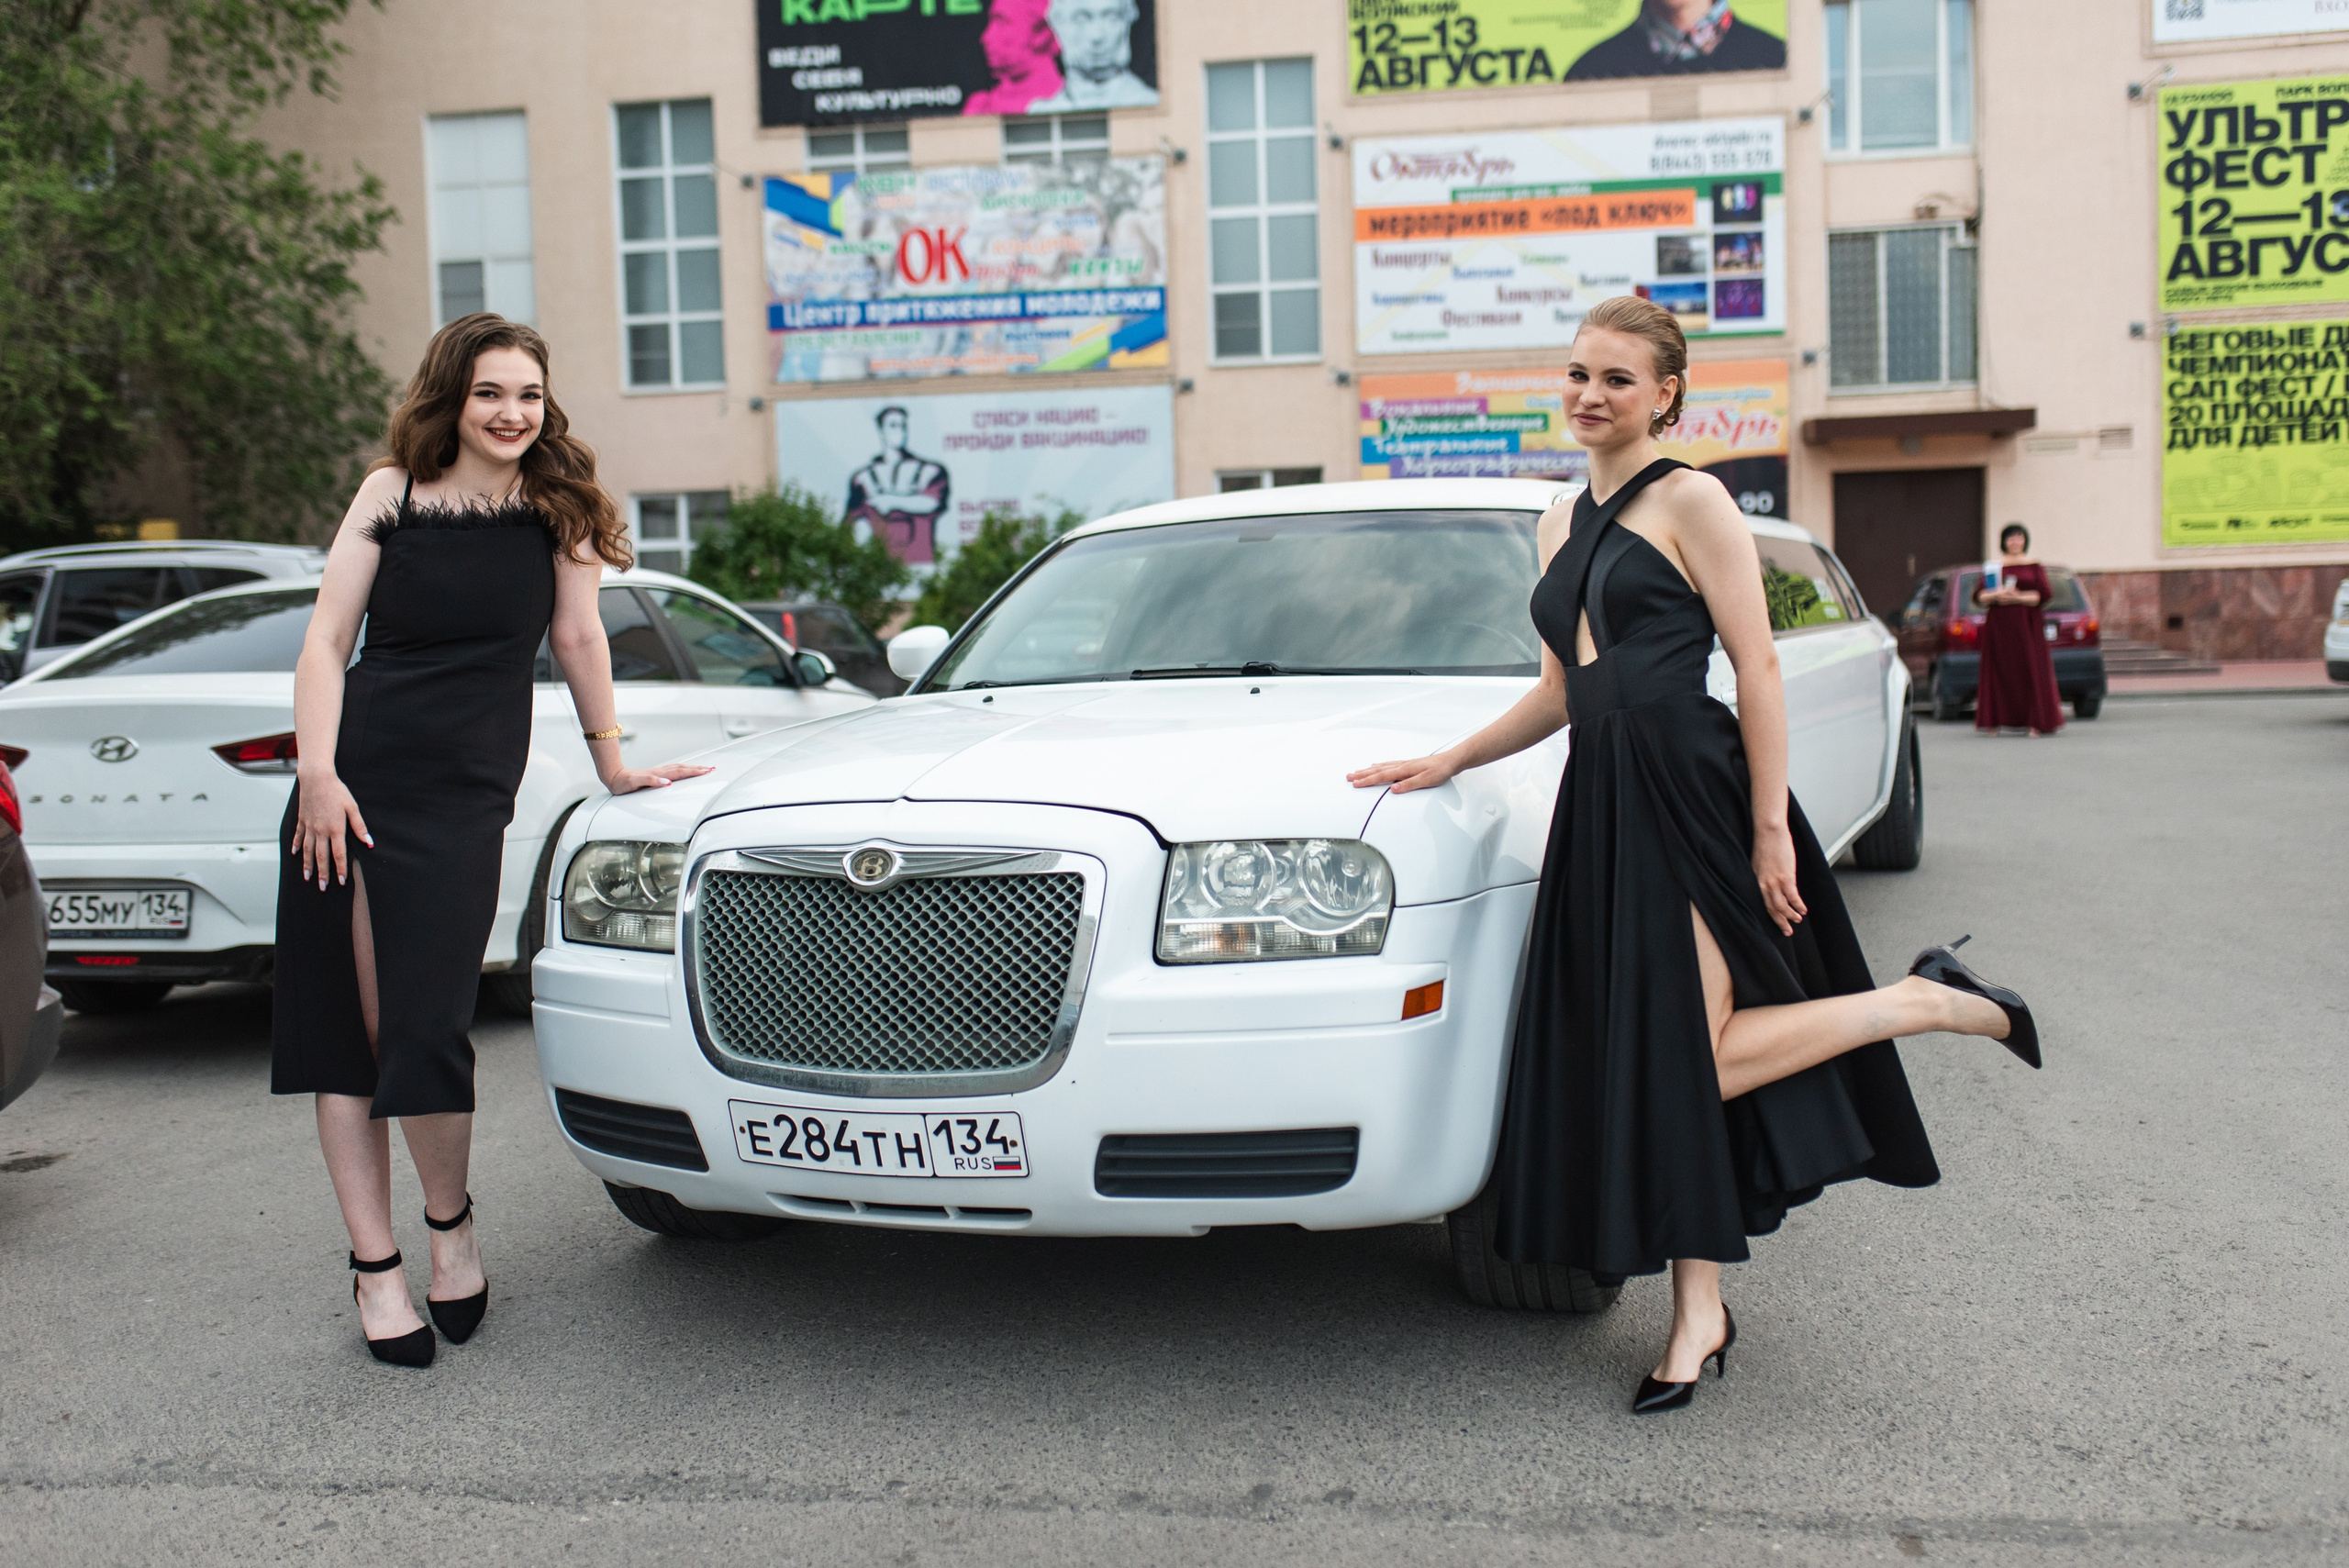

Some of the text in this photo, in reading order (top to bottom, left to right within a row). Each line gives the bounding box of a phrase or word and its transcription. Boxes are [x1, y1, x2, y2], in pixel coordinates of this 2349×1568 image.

[768, 45, 841, 68] ВЕДИ
[1357, 48, 1555, 92] АВГУСТА
[815, 85, 963, 112] КУЛЬТУРНО
[2165, 99, 2349, 150] УЛЬТР
[1370, 147, 1516, 185] Октябрь
[2165, 144, 2327, 197] ФЕСТ
[1370, 207, 1530, 240] мероприятие
[1371, 249, 1452, 269] Концерты
[2166, 233, 2349, 282] АВГУС
[1497, 284, 1573, 306] Конкурсы
[784, 289, 1162, 329] Центр притяжения молодежи
[2169, 328, 2314, 351] БЕГОВЫЕ
[2168, 379, 2228, 401] САП
[2235, 375, 2317, 400] ФЕСТ
[974, 410, 1029, 429] СПАСИ
[1035, 406, 1099, 427] НАЦИЮ
[1369, 396, 1481, 419] Вокальные
[2169, 405, 2204, 426] 20
[943, 430, 1014, 452] ПРОЙДИ
[1373, 434, 1509, 460] Театральные
[2167, 421, 2341, 452] ДЛЯ ДЕТЕЙ
[28, 792, 210, 805] SONATA
[47, 893, 180, 924] 655МУ 134
[932, 1118, 1010, 1156] 134
[954, 1157, 992, 1172] RUS
